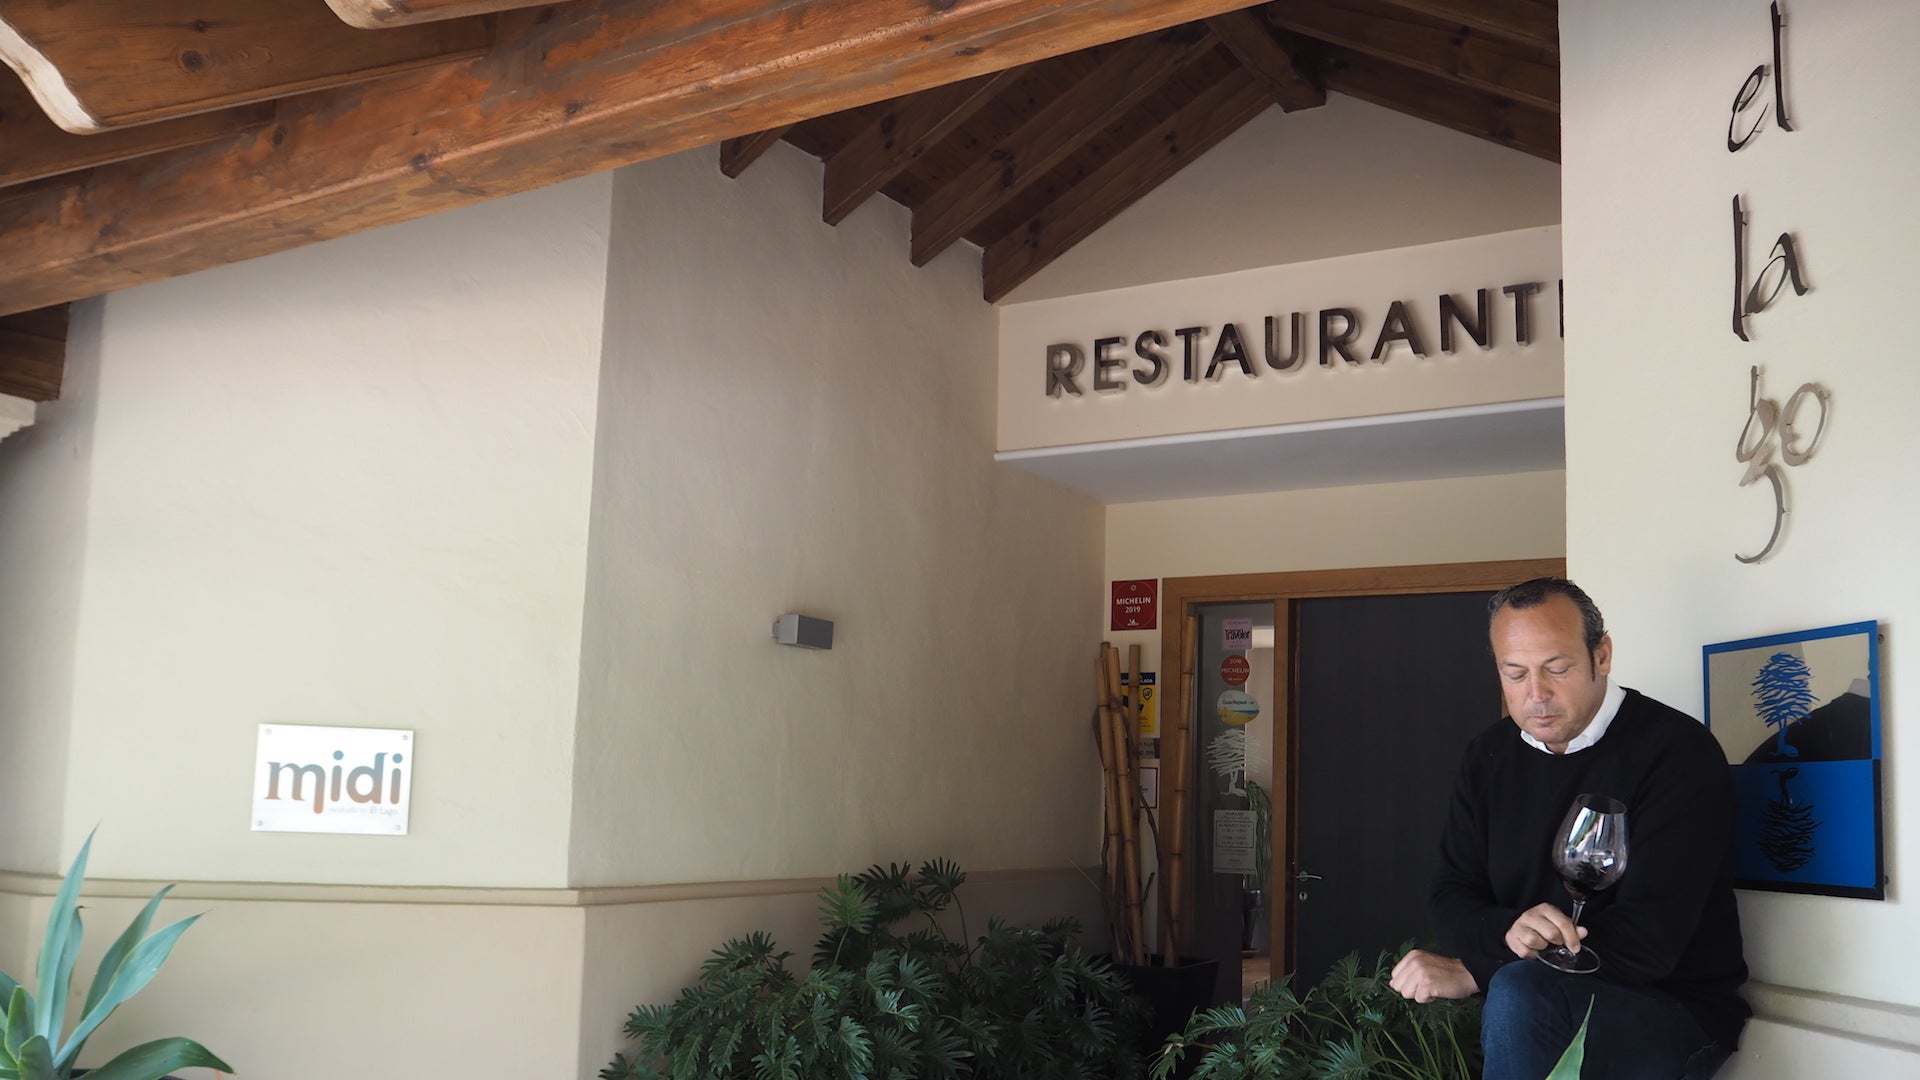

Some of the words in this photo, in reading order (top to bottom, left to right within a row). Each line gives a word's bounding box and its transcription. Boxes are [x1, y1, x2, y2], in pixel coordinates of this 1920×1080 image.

[1728, 0, 1794, 152] el
[1046, 278, 1565, 399] RESTAURANT
[1116, 596, 1152, 606] MICHELIN
[1125, 606, 1141, 614] 2019
[264, 750, 403, 814] midi
